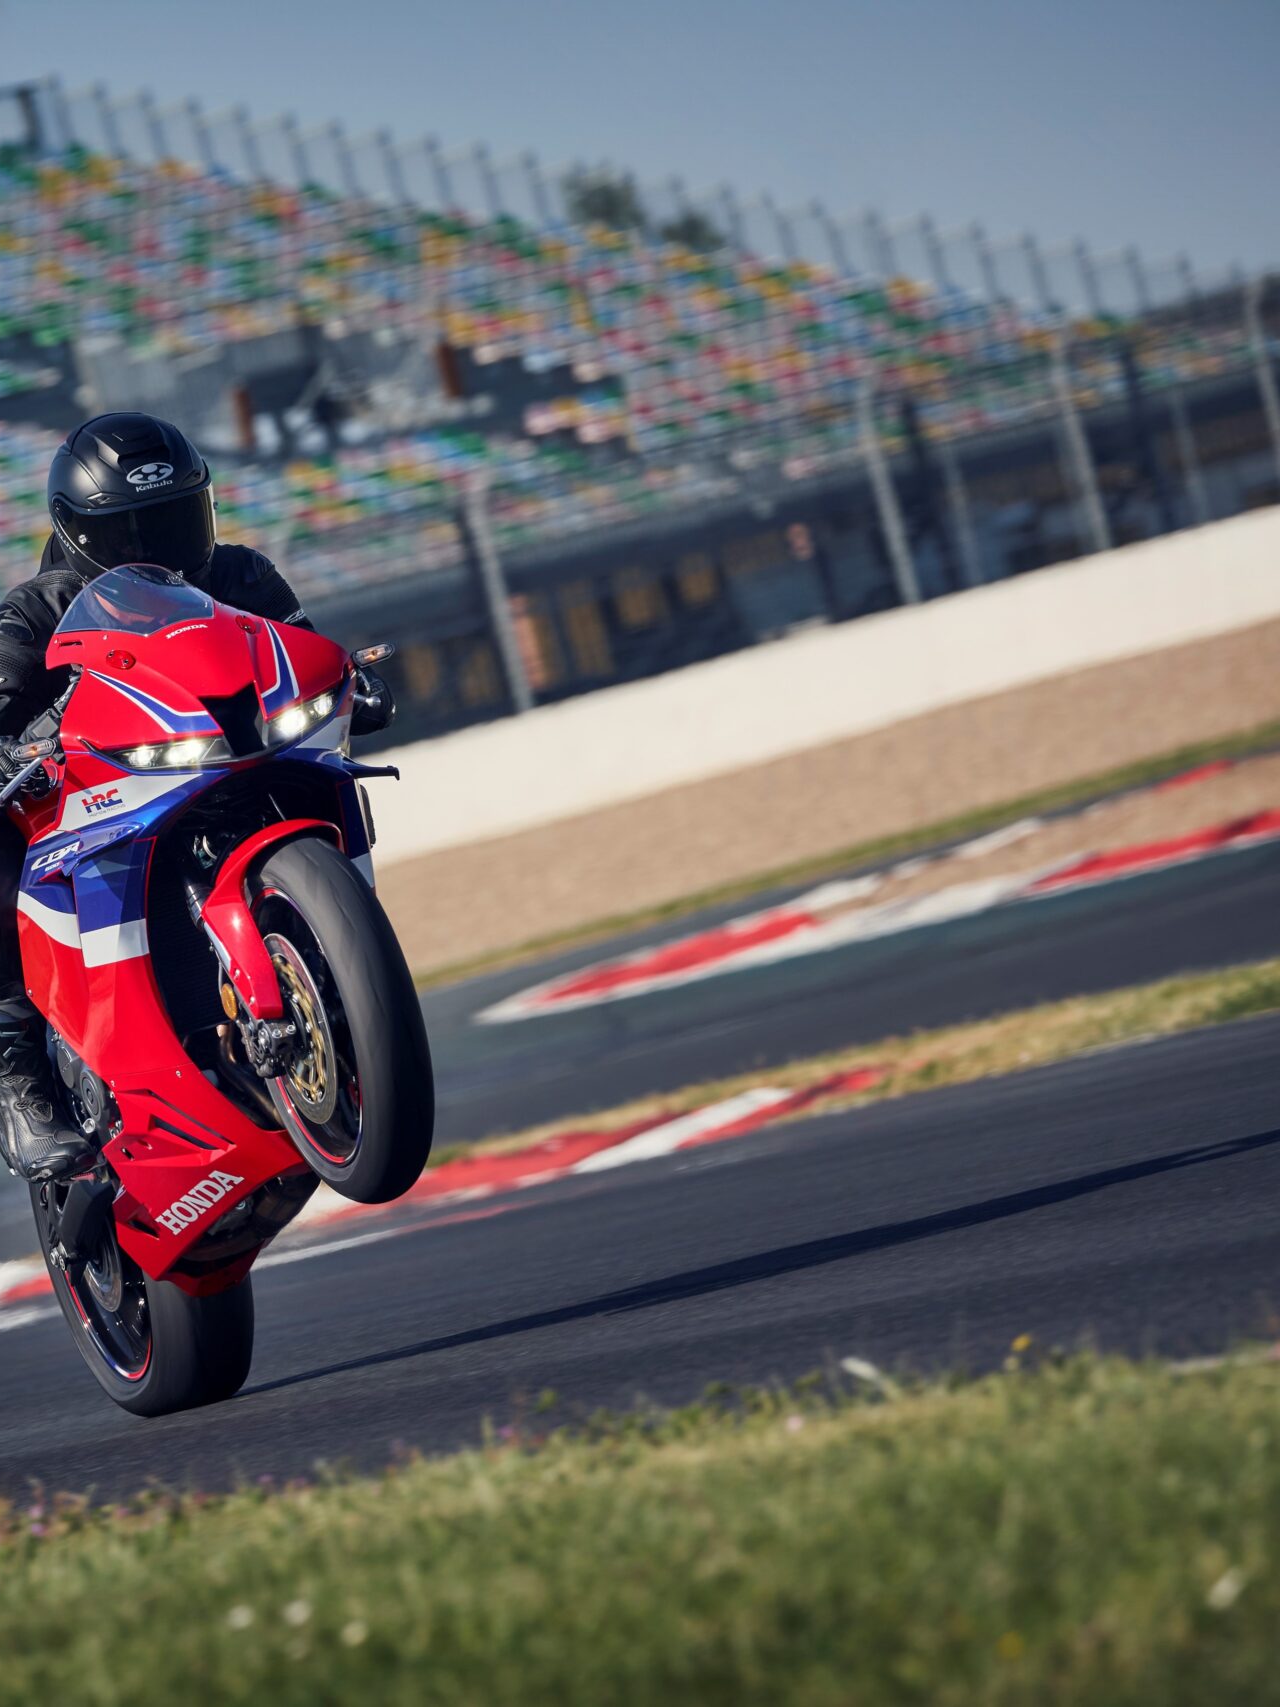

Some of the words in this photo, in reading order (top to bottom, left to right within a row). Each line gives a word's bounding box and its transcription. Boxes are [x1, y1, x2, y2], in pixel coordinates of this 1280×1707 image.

[135, 480, 173, 492] Kabuto
[166, 624, 208, 639] HONDA
[81, 788, 123, 813] HRC
[31, 841, 80, 871] CBR
[155, 1170, 245, 1236] HONDA
